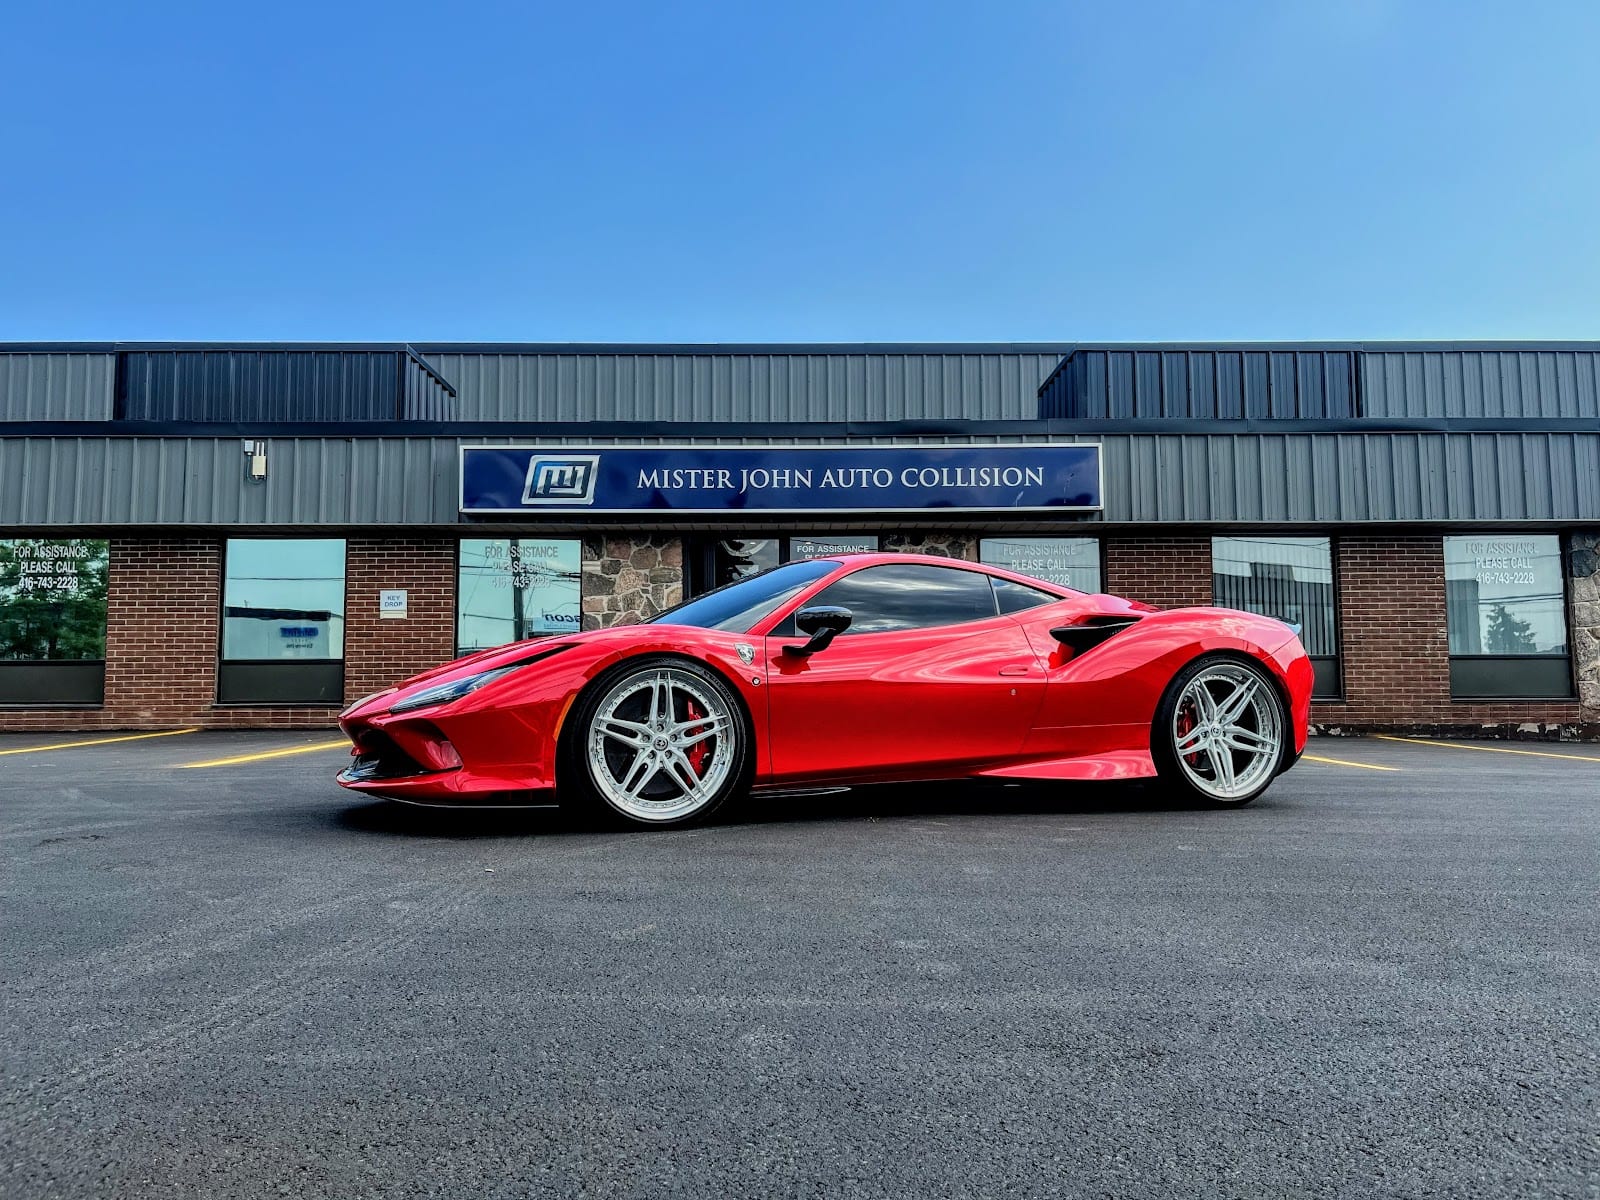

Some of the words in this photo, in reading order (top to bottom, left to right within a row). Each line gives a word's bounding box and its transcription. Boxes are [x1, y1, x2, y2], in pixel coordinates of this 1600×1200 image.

[636, 468, 736, 489] MISTER
[739, 468, 813, 495] JOHN
[819, 468, 894, 488] AUTO
[900, 467, 1044, 488] COLLISION
[14, 546, 31, 558] FOR
[34, 545, 87, 558] ASSISTANCE
[485, 545, 503, 558] FOR
[506, 545, 559, 558] ASSISTANCE
[797, 545, 815, 553] FOR
[818, 545, 870, 553] ASSISTANCE
[20, 561, 53, 573] PLEASE
[56, 561, 78, 573] CALL
[1011, 559, 1043, 571] PLEASE
[1047, 559, 1069, 571] CALL
[1475, 557, 1508, 569] PLEASE
[1511, 557, 1533, 569] CALL
[19, 577, 78, 589] 416-743-2228
[1475, 572, 1535, 584] 416-743-2228
